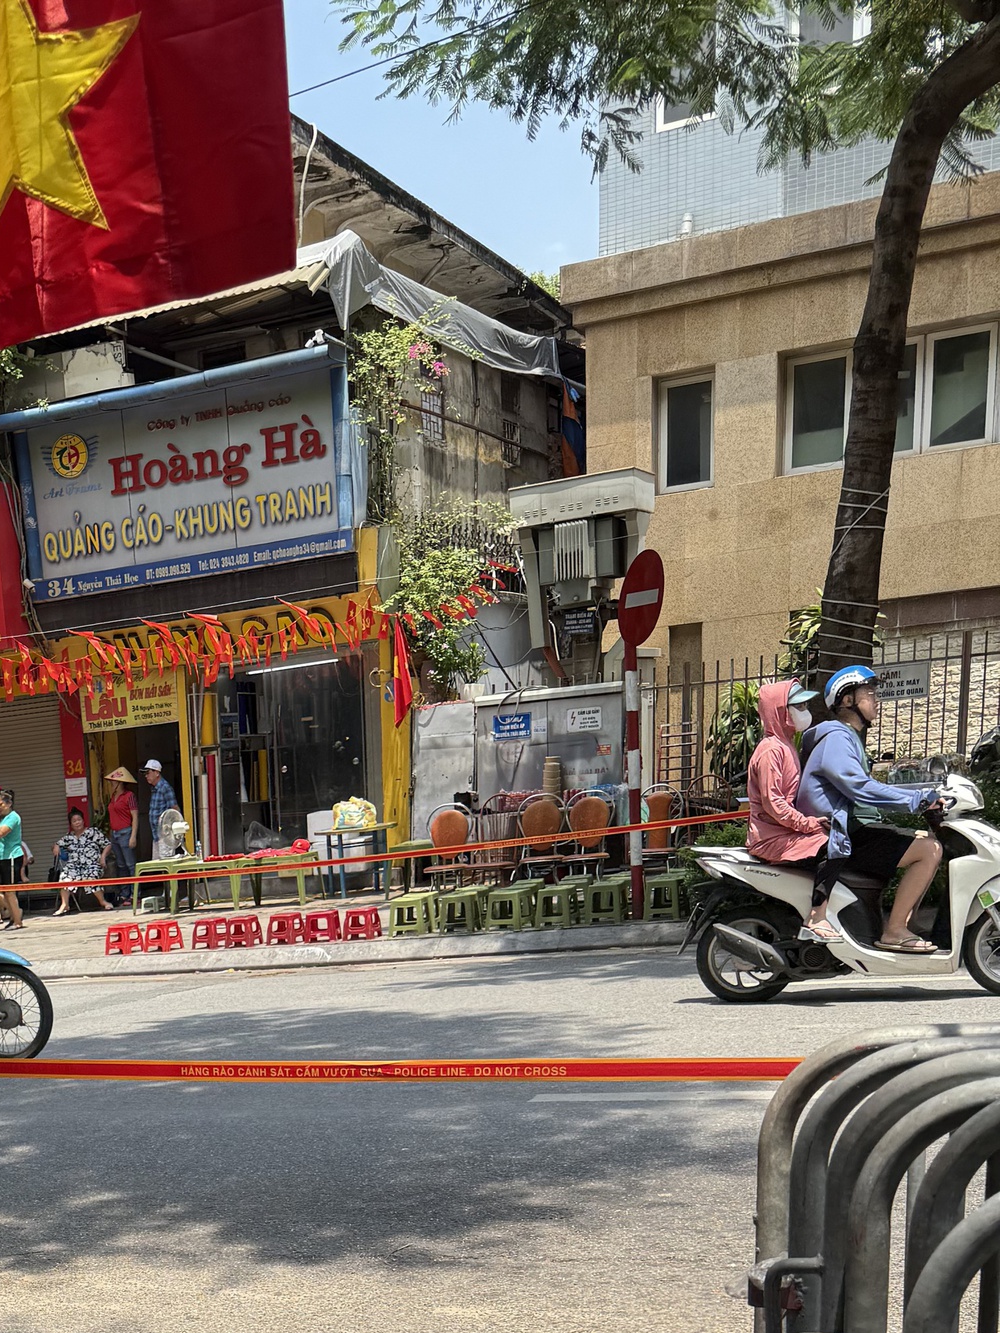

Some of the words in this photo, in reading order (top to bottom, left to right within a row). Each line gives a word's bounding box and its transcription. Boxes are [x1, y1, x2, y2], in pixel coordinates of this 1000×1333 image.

[147, 418, 176, 431] Công
[180, 415, 191, 426] ty
[195, 408, 222, 422] TNHH
[268, 393, 292, 407] cáo
[108, 443, 251, 496] Hoàng
[259, 414, 327, 468] Hà
[43, 483, 64, 500] Art
[44, 511, 116, 563] QUẢNG
[254, 481, 332, 526] TRANH
[48, 577, 76, 598] 34
[105, 575, 122, 587] Thái
[124, 573, 139, 584] Học
[253, 551, 272, 562] Email:
[905, 678, 920, 686] MÁY
[131, 705, 139, 713] 34
[66, 759, 84, 776] 34
[180, 1065, 210, 1077] HÀNG
[212, 1065, 235, 1077] RÀO
[296, 1064, 320, 1077] CẤM
[323, 1067, 356, 1079] VƯỢT
[394, 1067, 437, 1077] POLICE
[440, 1067, 470, 1077] LINE.
[474, 1066, 492, 1077] DO
[495, 1066, 521, 1077] NOT
[523, 1066, 567, 1076] CROSS
